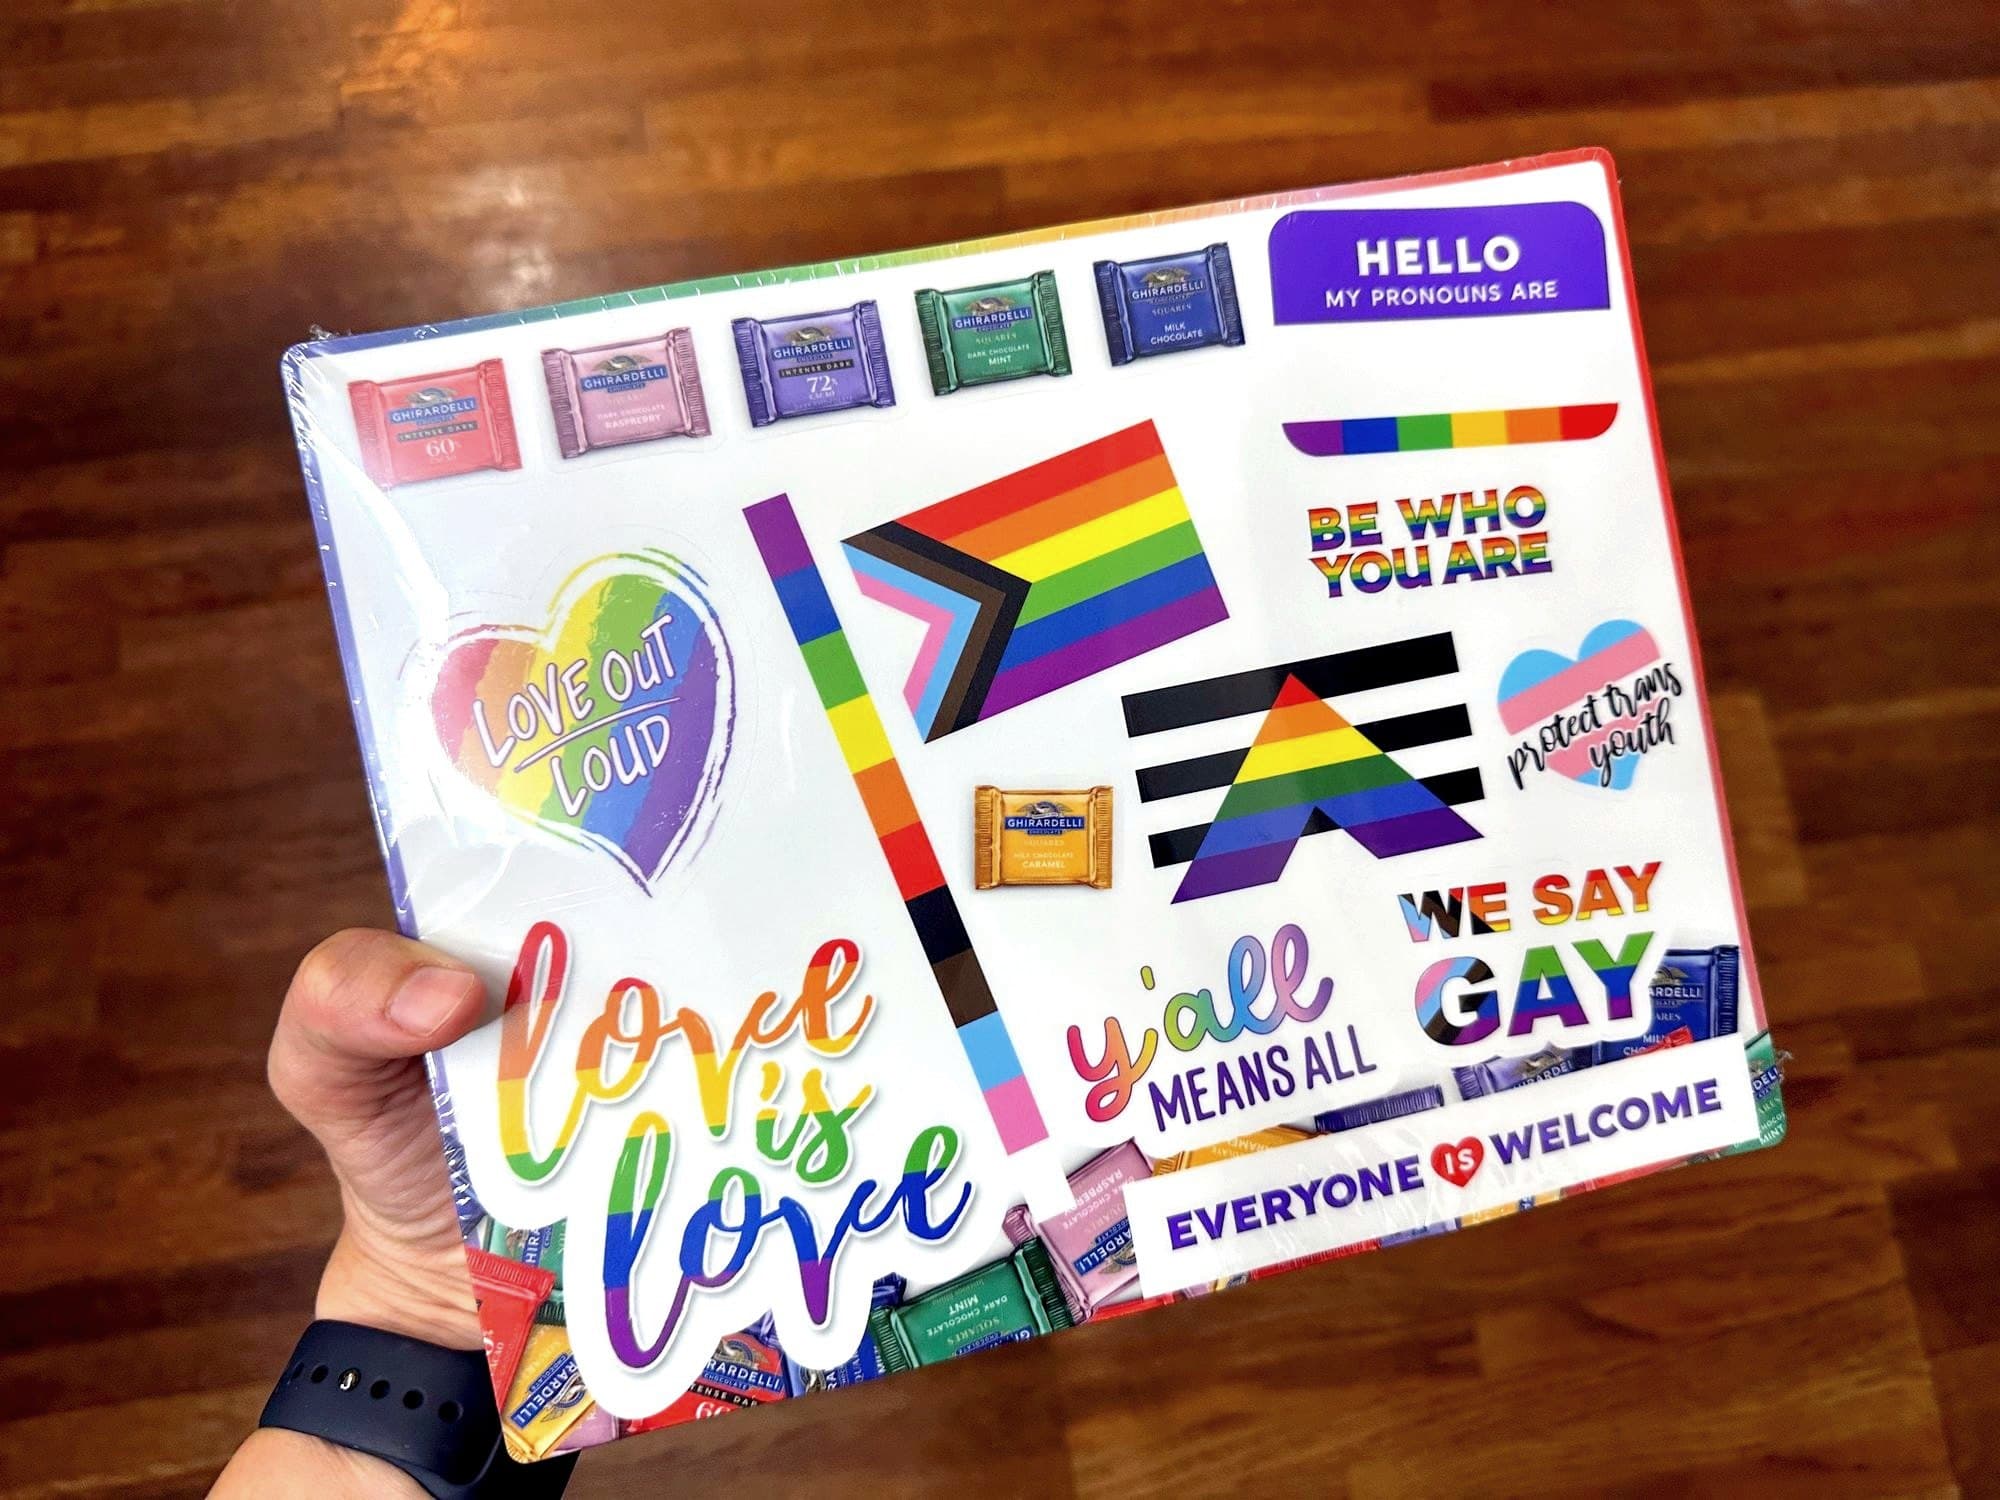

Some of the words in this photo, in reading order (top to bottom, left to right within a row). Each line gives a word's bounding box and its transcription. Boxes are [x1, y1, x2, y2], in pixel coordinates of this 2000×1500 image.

[1356, 235, 1520, 277] HELLO
[1131, 280, 1204, 300] GHIRARDELLI
[1325, 288, 1361, 309] MY
[1371, 283, 1502, 307] PRONOUNS
[1510, 280, 1559, 301] ARE
[955, 309, 1029, 329] GHIRARDELLI
[1164, 321, 1186, 333] MILK
[774, 339, 851, 359] GHIRARDELLI
[988, 344, 1030, 356] CHOCOLATE
[1150, 329, 1204, 345] CHOCOLATE
[781, 365, 822, 377] INTENSE
[826, 360, 852, 370] DARK
[988, 355, 1012, 366] MINT
[584, 368, 665, 389] GHIRARDELLI
[392, 400, 475, 422] GHIRARDELLI
[1307, 500, 1383, 552] BE
[1396, 485, 1547, 541] WHO
[1309, 544, 1433, 598] YOU
[1442, 531, 1553, 585] ARE
[472, 658, 593, 768] LOVE
[602, 613, 676, 702] OUT
[1507, 694, 1603, 791] protect
[1602, 662, 1682, 718] trans
[1589, 697, 1675, 788] youth
[550, 714, 671, 817] LOUD
[1007, 817, 1082, 828] GHIRARDELLI
[1397, 882, 1512, 943] WE
[1532, 861, 1663, 926] SAY
[1414, 930, 1655, 1047] GAY
[1648, 987, 1700, 998] ARDELLI
[1066, 923, 1334, 1122] y'all
[496, 920, 873, 1181] love
[1148, 1045, 1296, 1132] MEANS
[1304, 1024, 1378, 1090] ALL
[755, 1061, 872, 1183] is
[1166, 1154, 1425, 1250] EVERYONE
[1444, 1148, 1475, 1175] IS
[1488, 1078, 1723, 1165] WELCOME
[602, 1110, 973, 1369] love
[1078, 1229, 1133, 1273] ARDELLI
[948, 1294, 979, 1316] MINT
[983, 1294, 1009, 1313] DARK
[926, 1307, 981, 1337] CHOCOLATE
[706, 1360, 781, 1390] RARDELLI
[517, 1360, 578, 1424] RARDELLI
[690, 1383, 728, 1400] TENSE
[733, 1394, 759, 1408] DAR
